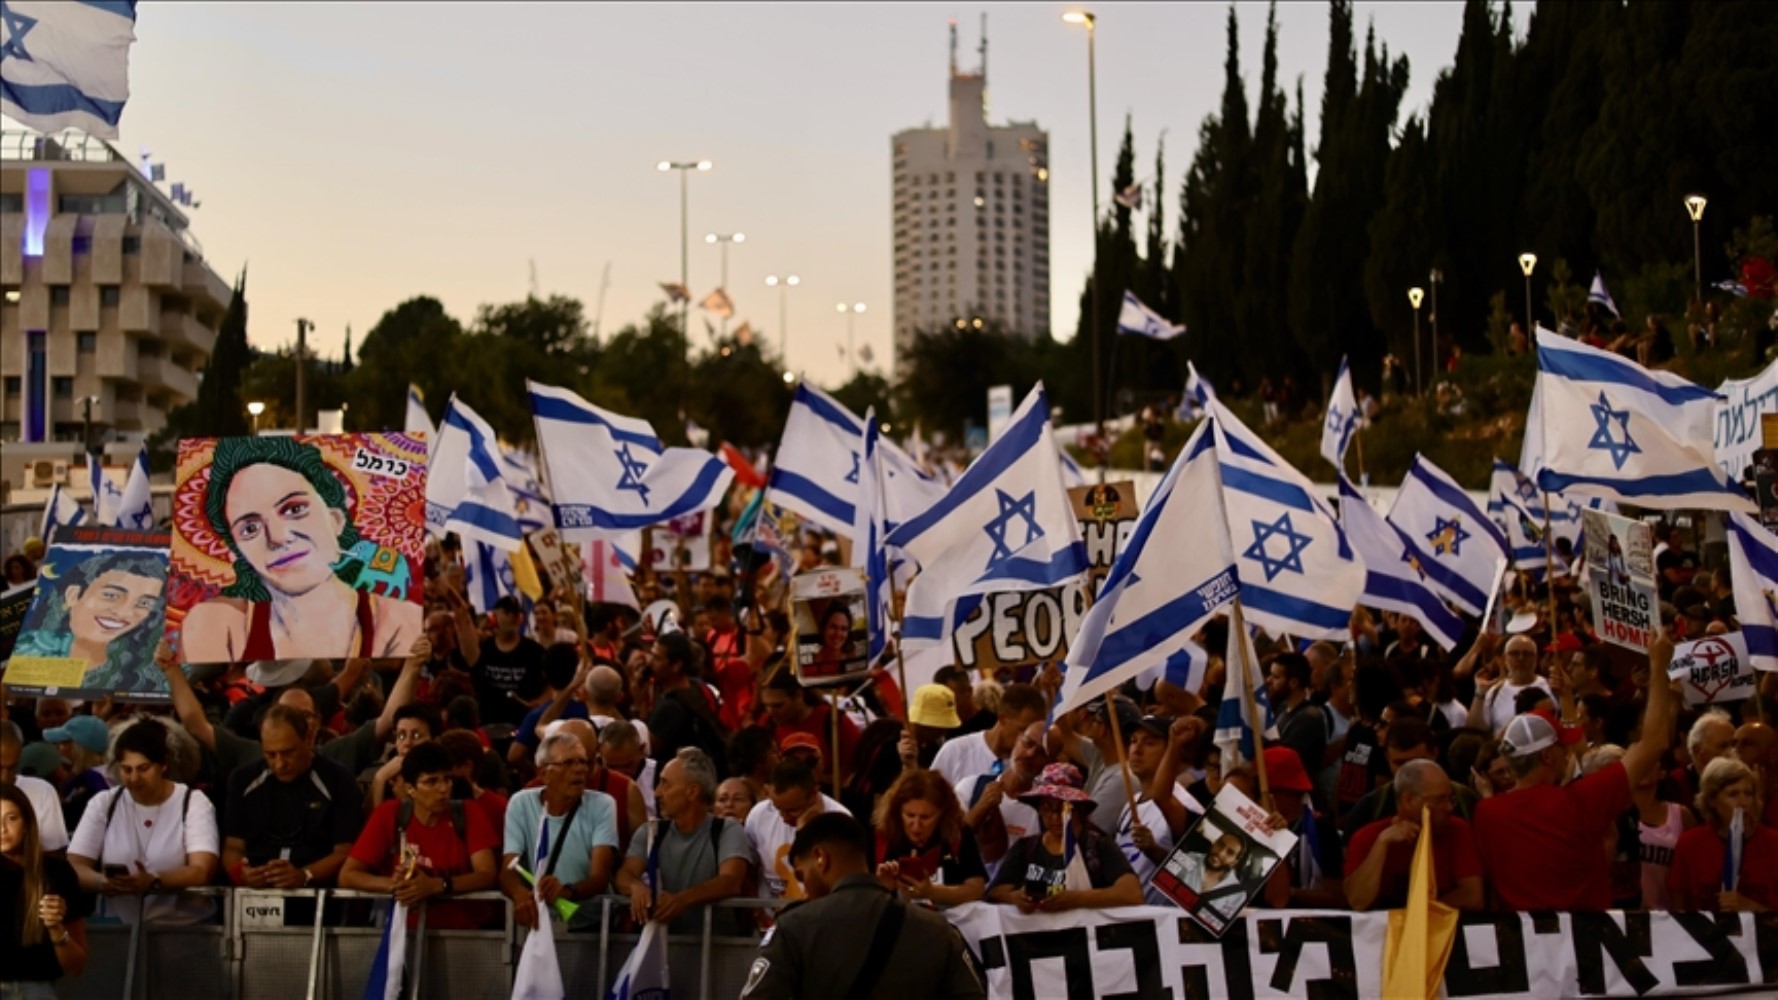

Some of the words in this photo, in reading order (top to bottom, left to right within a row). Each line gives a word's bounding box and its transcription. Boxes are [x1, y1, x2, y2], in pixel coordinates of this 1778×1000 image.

[356, 449, 407, 475] כרמל
[1600, 581, 1649, 611] BRING
[1602, 600, 1650, 630] HERSH
[1604, 619, 1651, 649] HOME
[1690, 656, 1739, 684] HERSH
